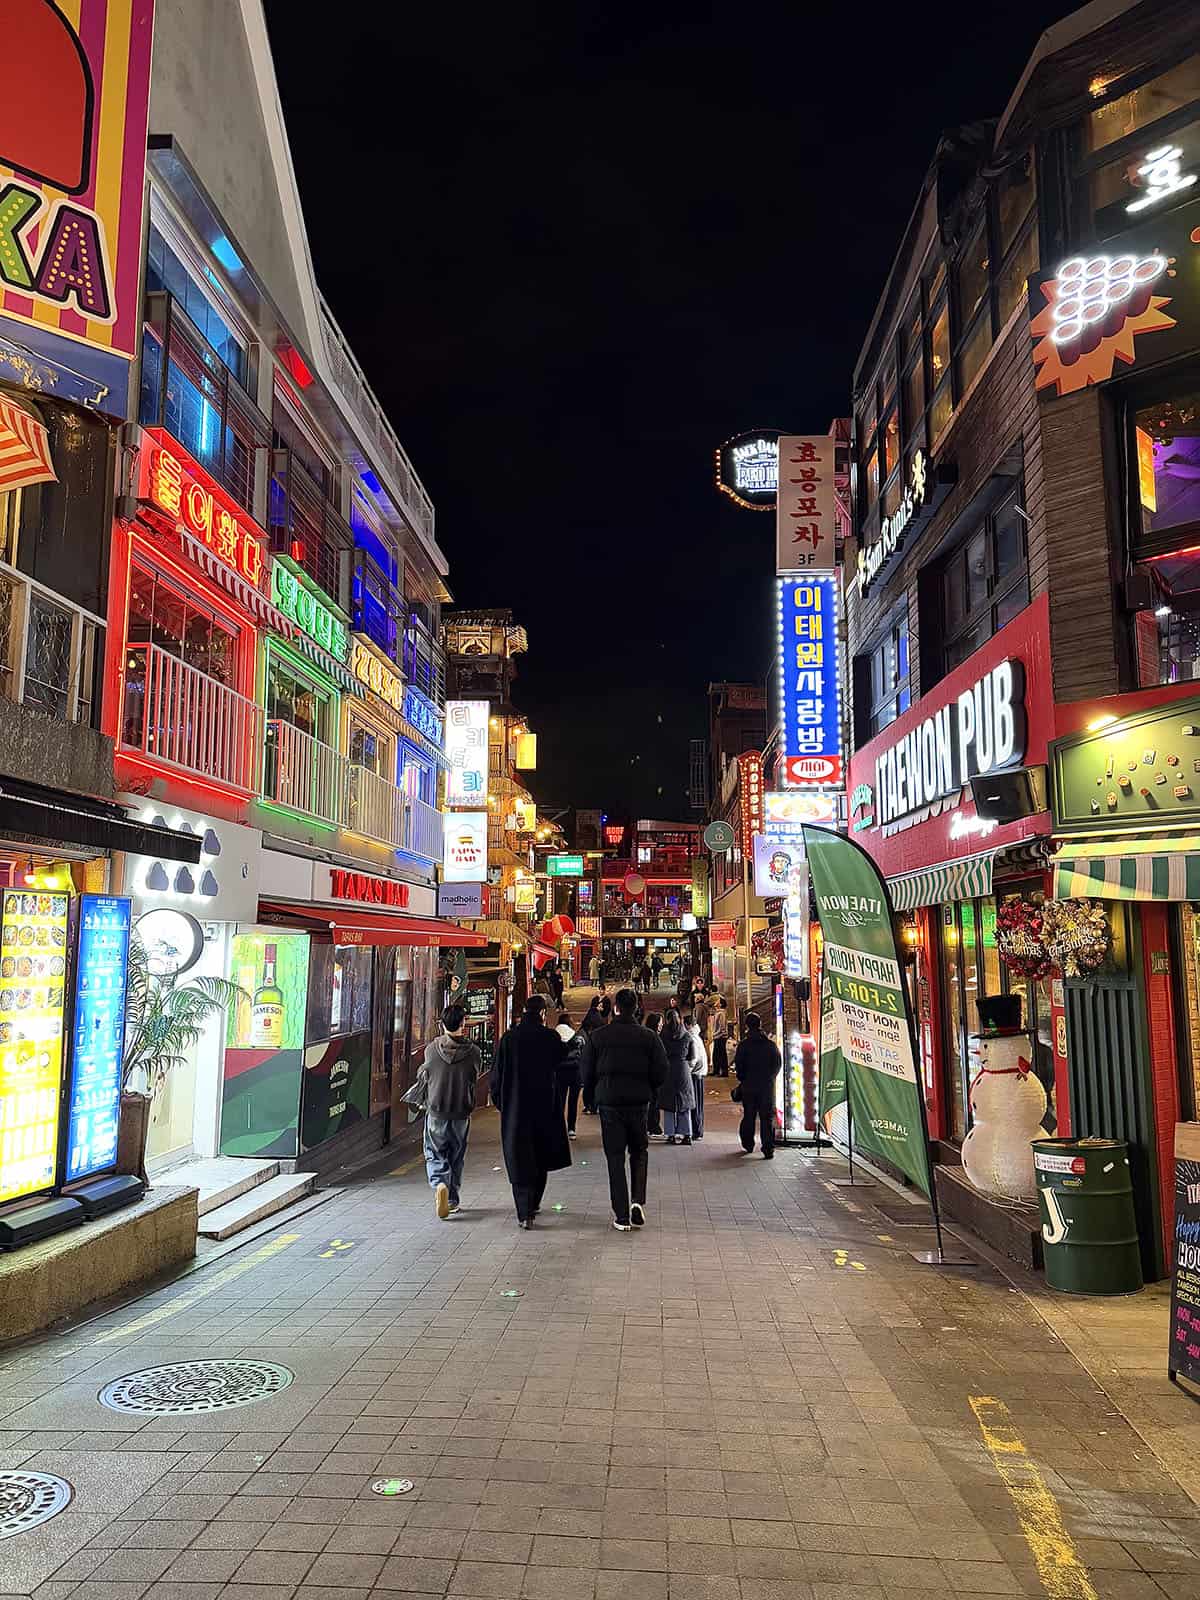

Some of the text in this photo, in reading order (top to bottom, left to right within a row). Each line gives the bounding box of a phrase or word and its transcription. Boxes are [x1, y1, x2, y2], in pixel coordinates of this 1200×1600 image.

[789, 441, 825, 550] 효봉포차
[797, 553, 816, 565] 3F
[794, 585, 826, 755] 이태원사랑방
[875, 661, 1017, 828] ITAEWON PUB
[748, 762, 760, 815] HOUSE
[329, 869, 410, 908] TAPAS BAR
[441, 895, 479, 903] madholic
